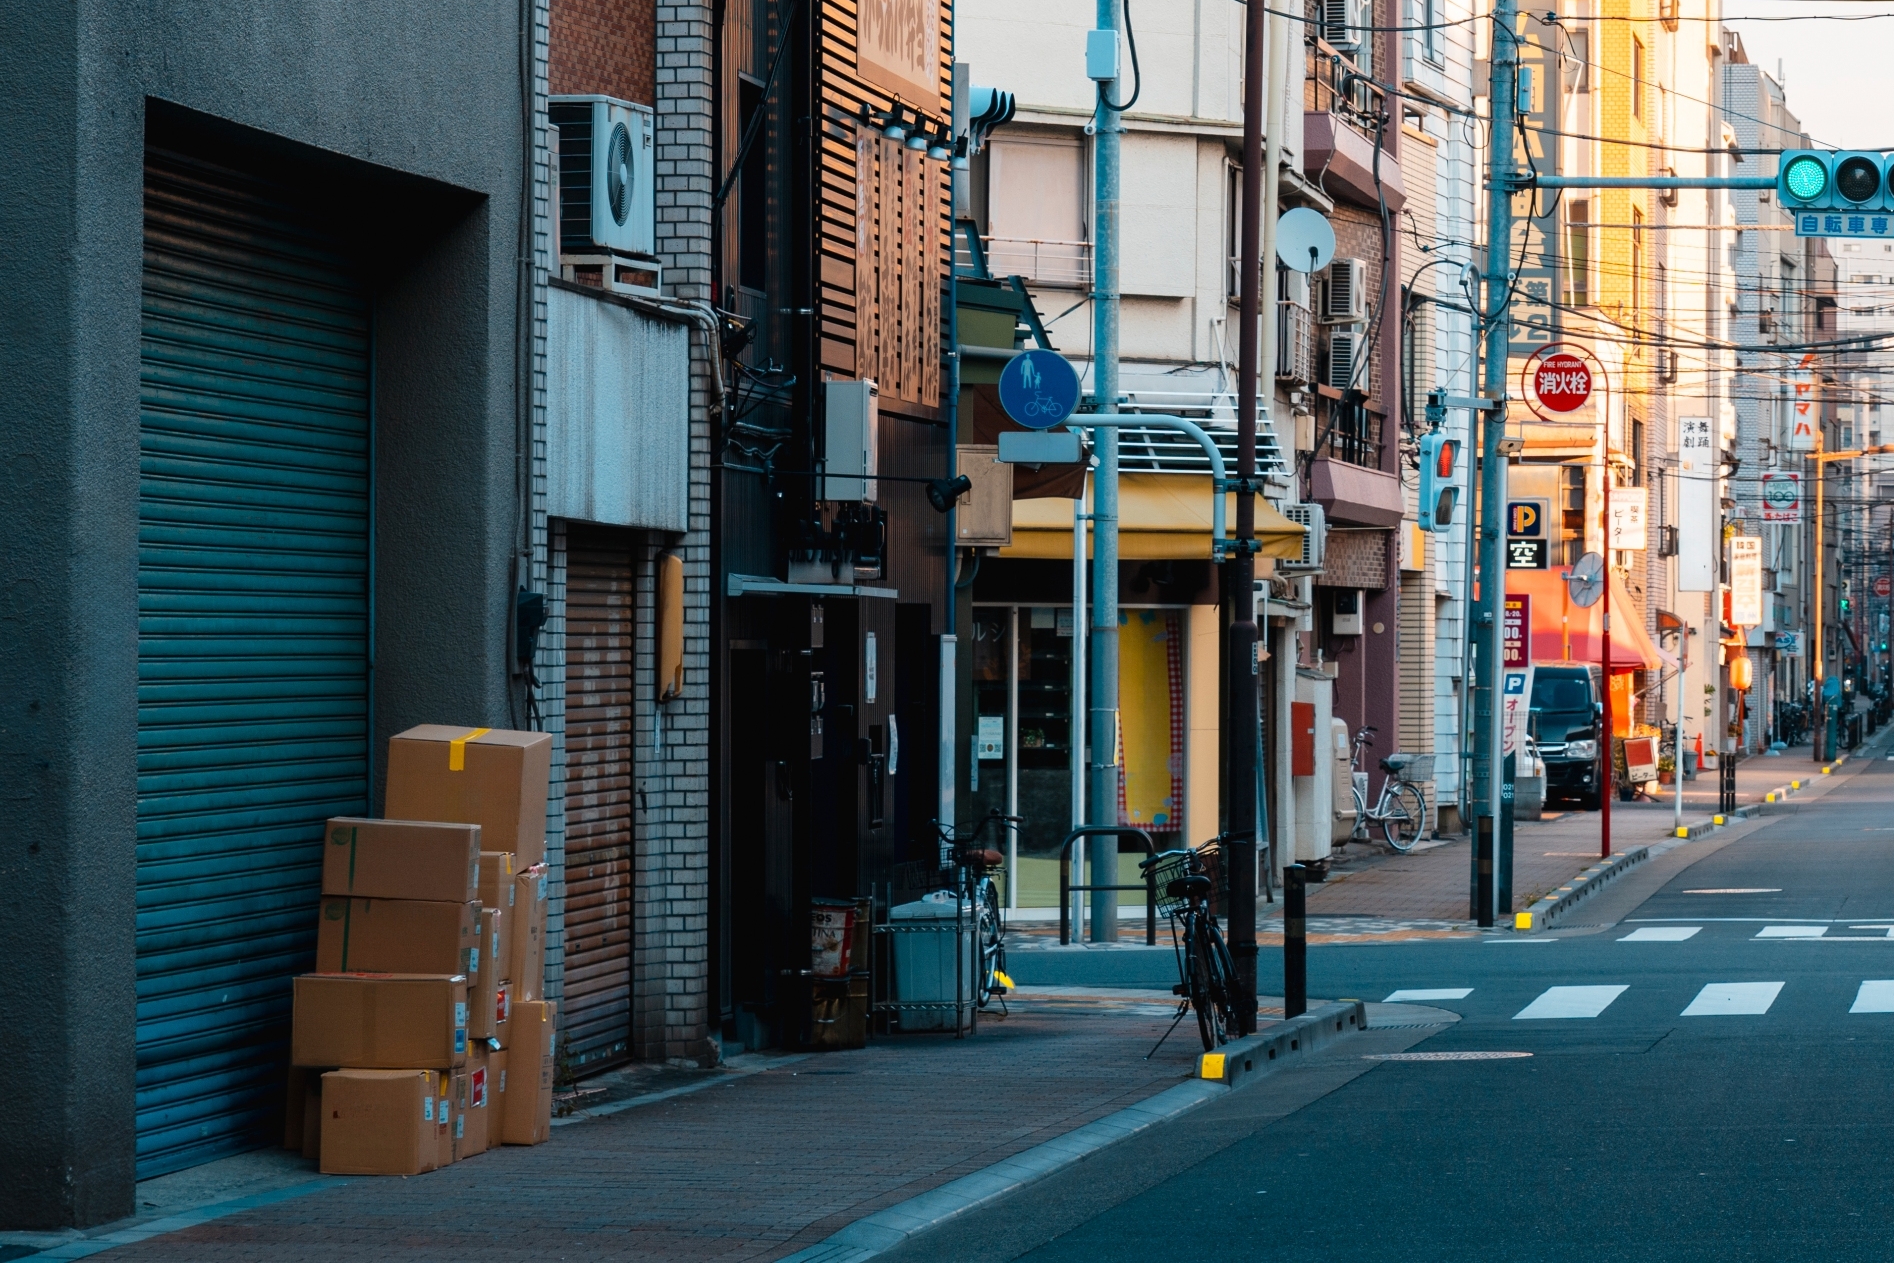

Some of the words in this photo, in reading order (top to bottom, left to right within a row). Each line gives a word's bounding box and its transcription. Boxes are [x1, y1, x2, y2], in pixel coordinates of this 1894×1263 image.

[1539, 371, 1588, 394] 消火栓
[1768, 491, 1795, 502] 100
[1509, 541, 1537, 567] 空
[1503, 698, 1519, 752] オープン
